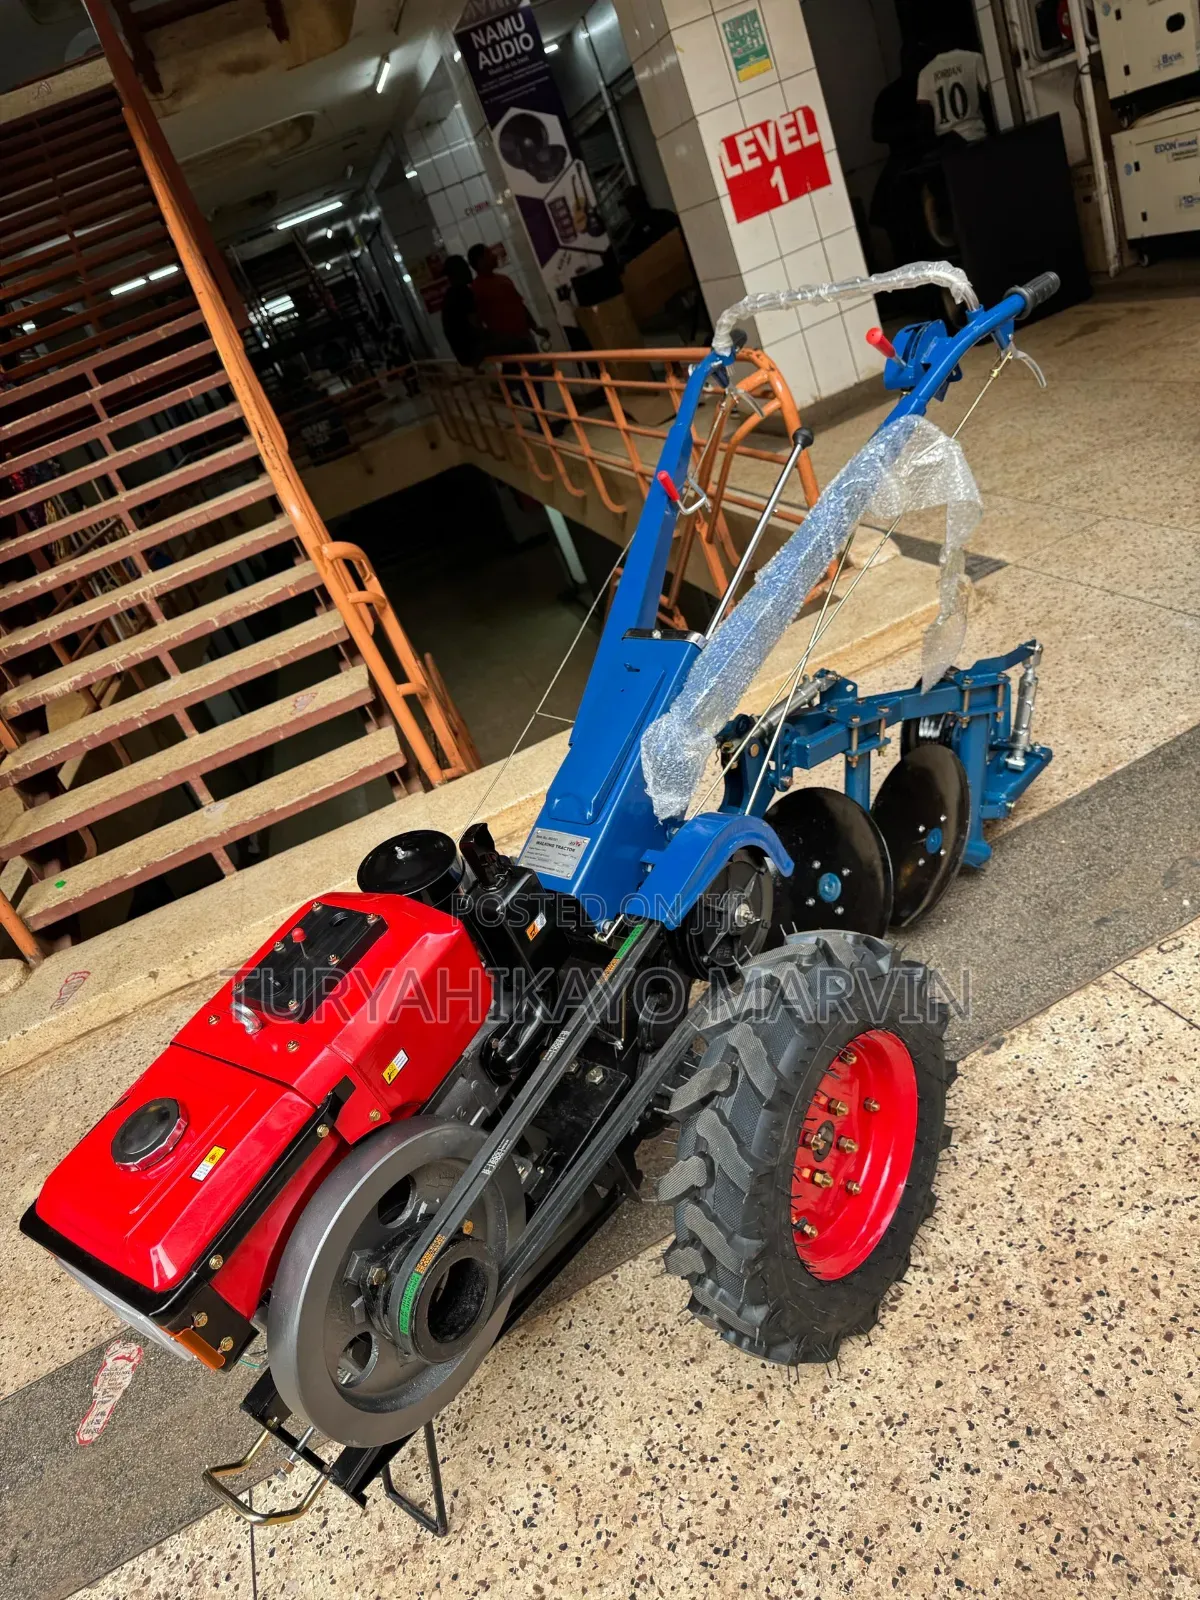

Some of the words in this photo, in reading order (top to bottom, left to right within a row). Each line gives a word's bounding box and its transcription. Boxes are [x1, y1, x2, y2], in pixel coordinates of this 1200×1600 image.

[470, 12, 526, 49] NAMU
[478, 33, 534, 71] AUDIO
[936, 82, 968, 125] 10
[719, 109, 820, 179] LEVEL
[770, 165, 790, 203] 1
[555, 844, 576, 852] TRACTOR
